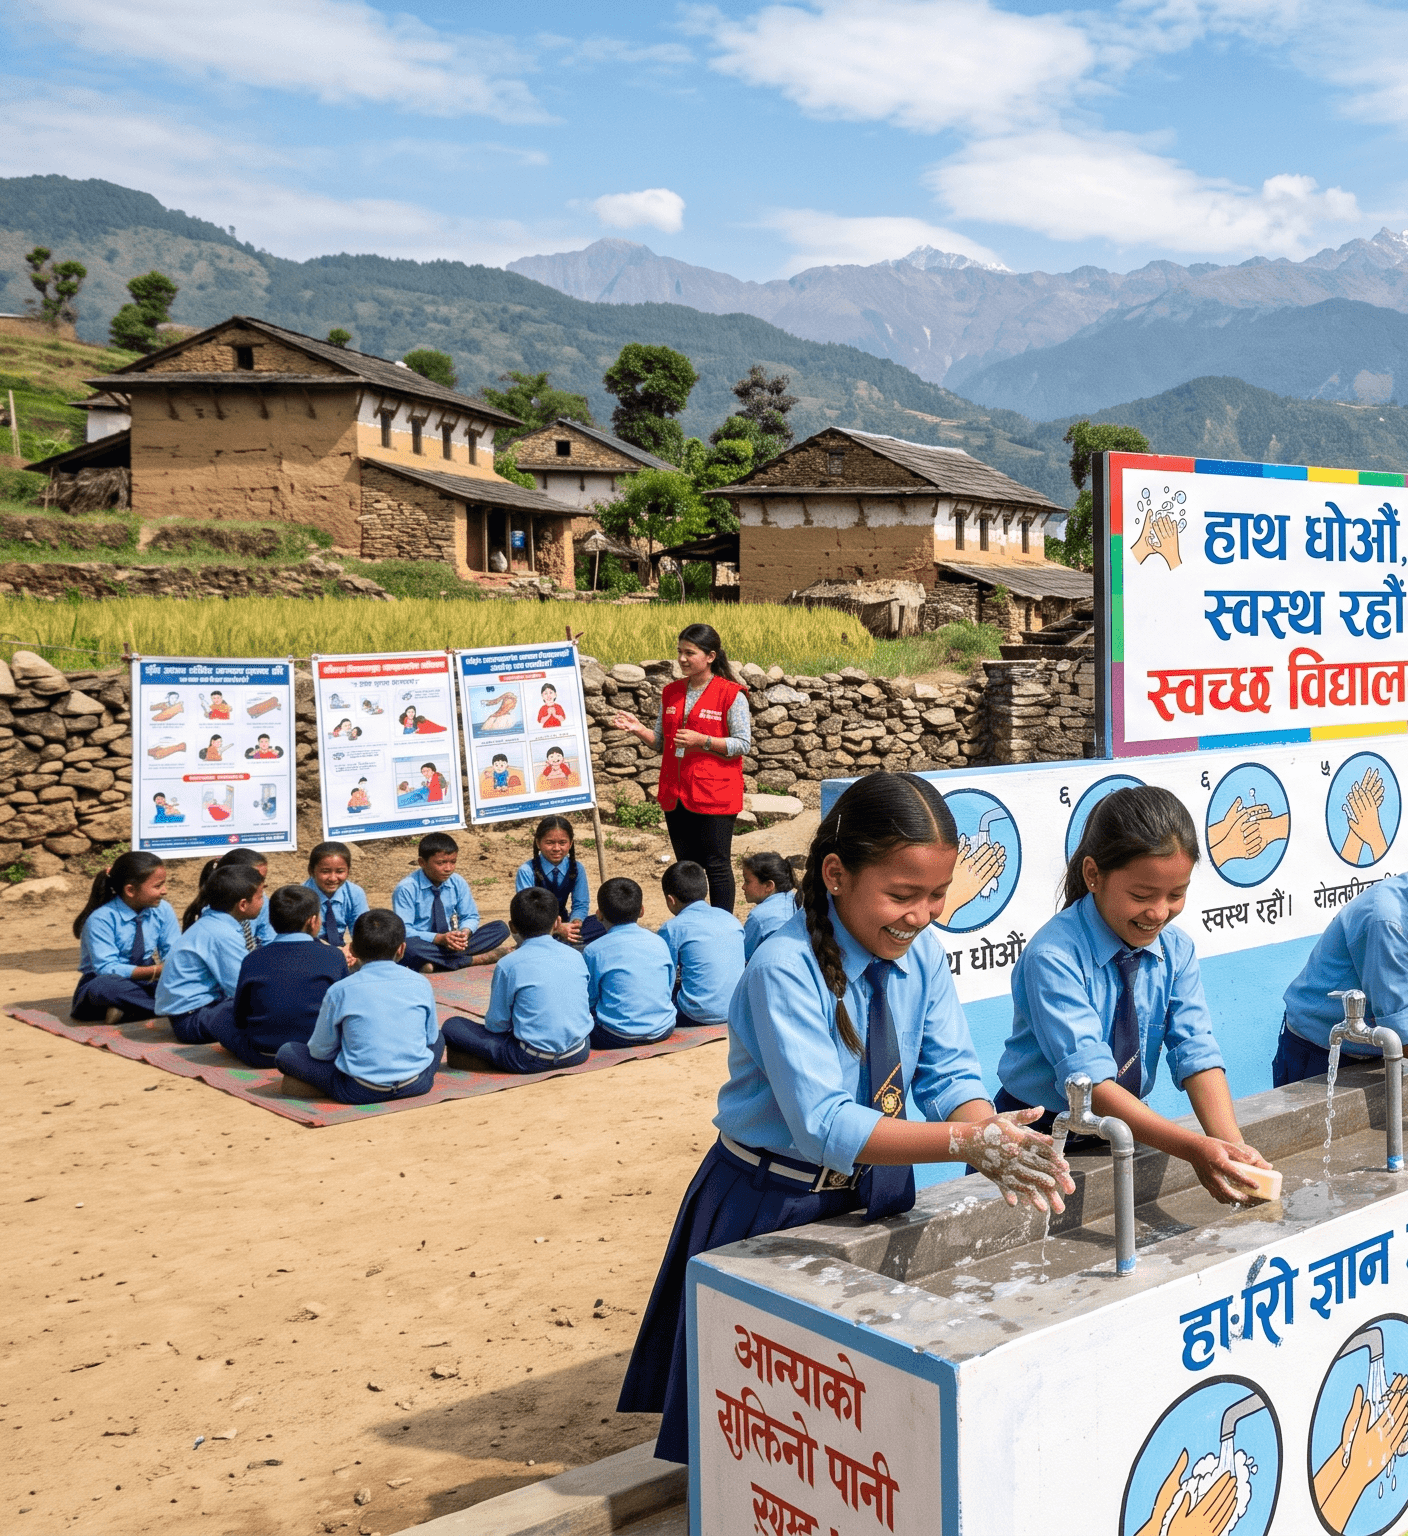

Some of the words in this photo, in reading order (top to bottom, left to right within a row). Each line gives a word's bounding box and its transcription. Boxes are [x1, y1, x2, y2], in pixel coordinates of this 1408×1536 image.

[1204, 511, 1290, 565] हाथ
[1204, 590, 1325, 640] स्वस्थ
[1147, 665, 1273, 722] स्वच्छ
[1202, 902, 1250, 933] स्वस्थ
[1309, 1230, 1394, 1320] ज्ञान
[824, 1445, 900, 1533] पानी
